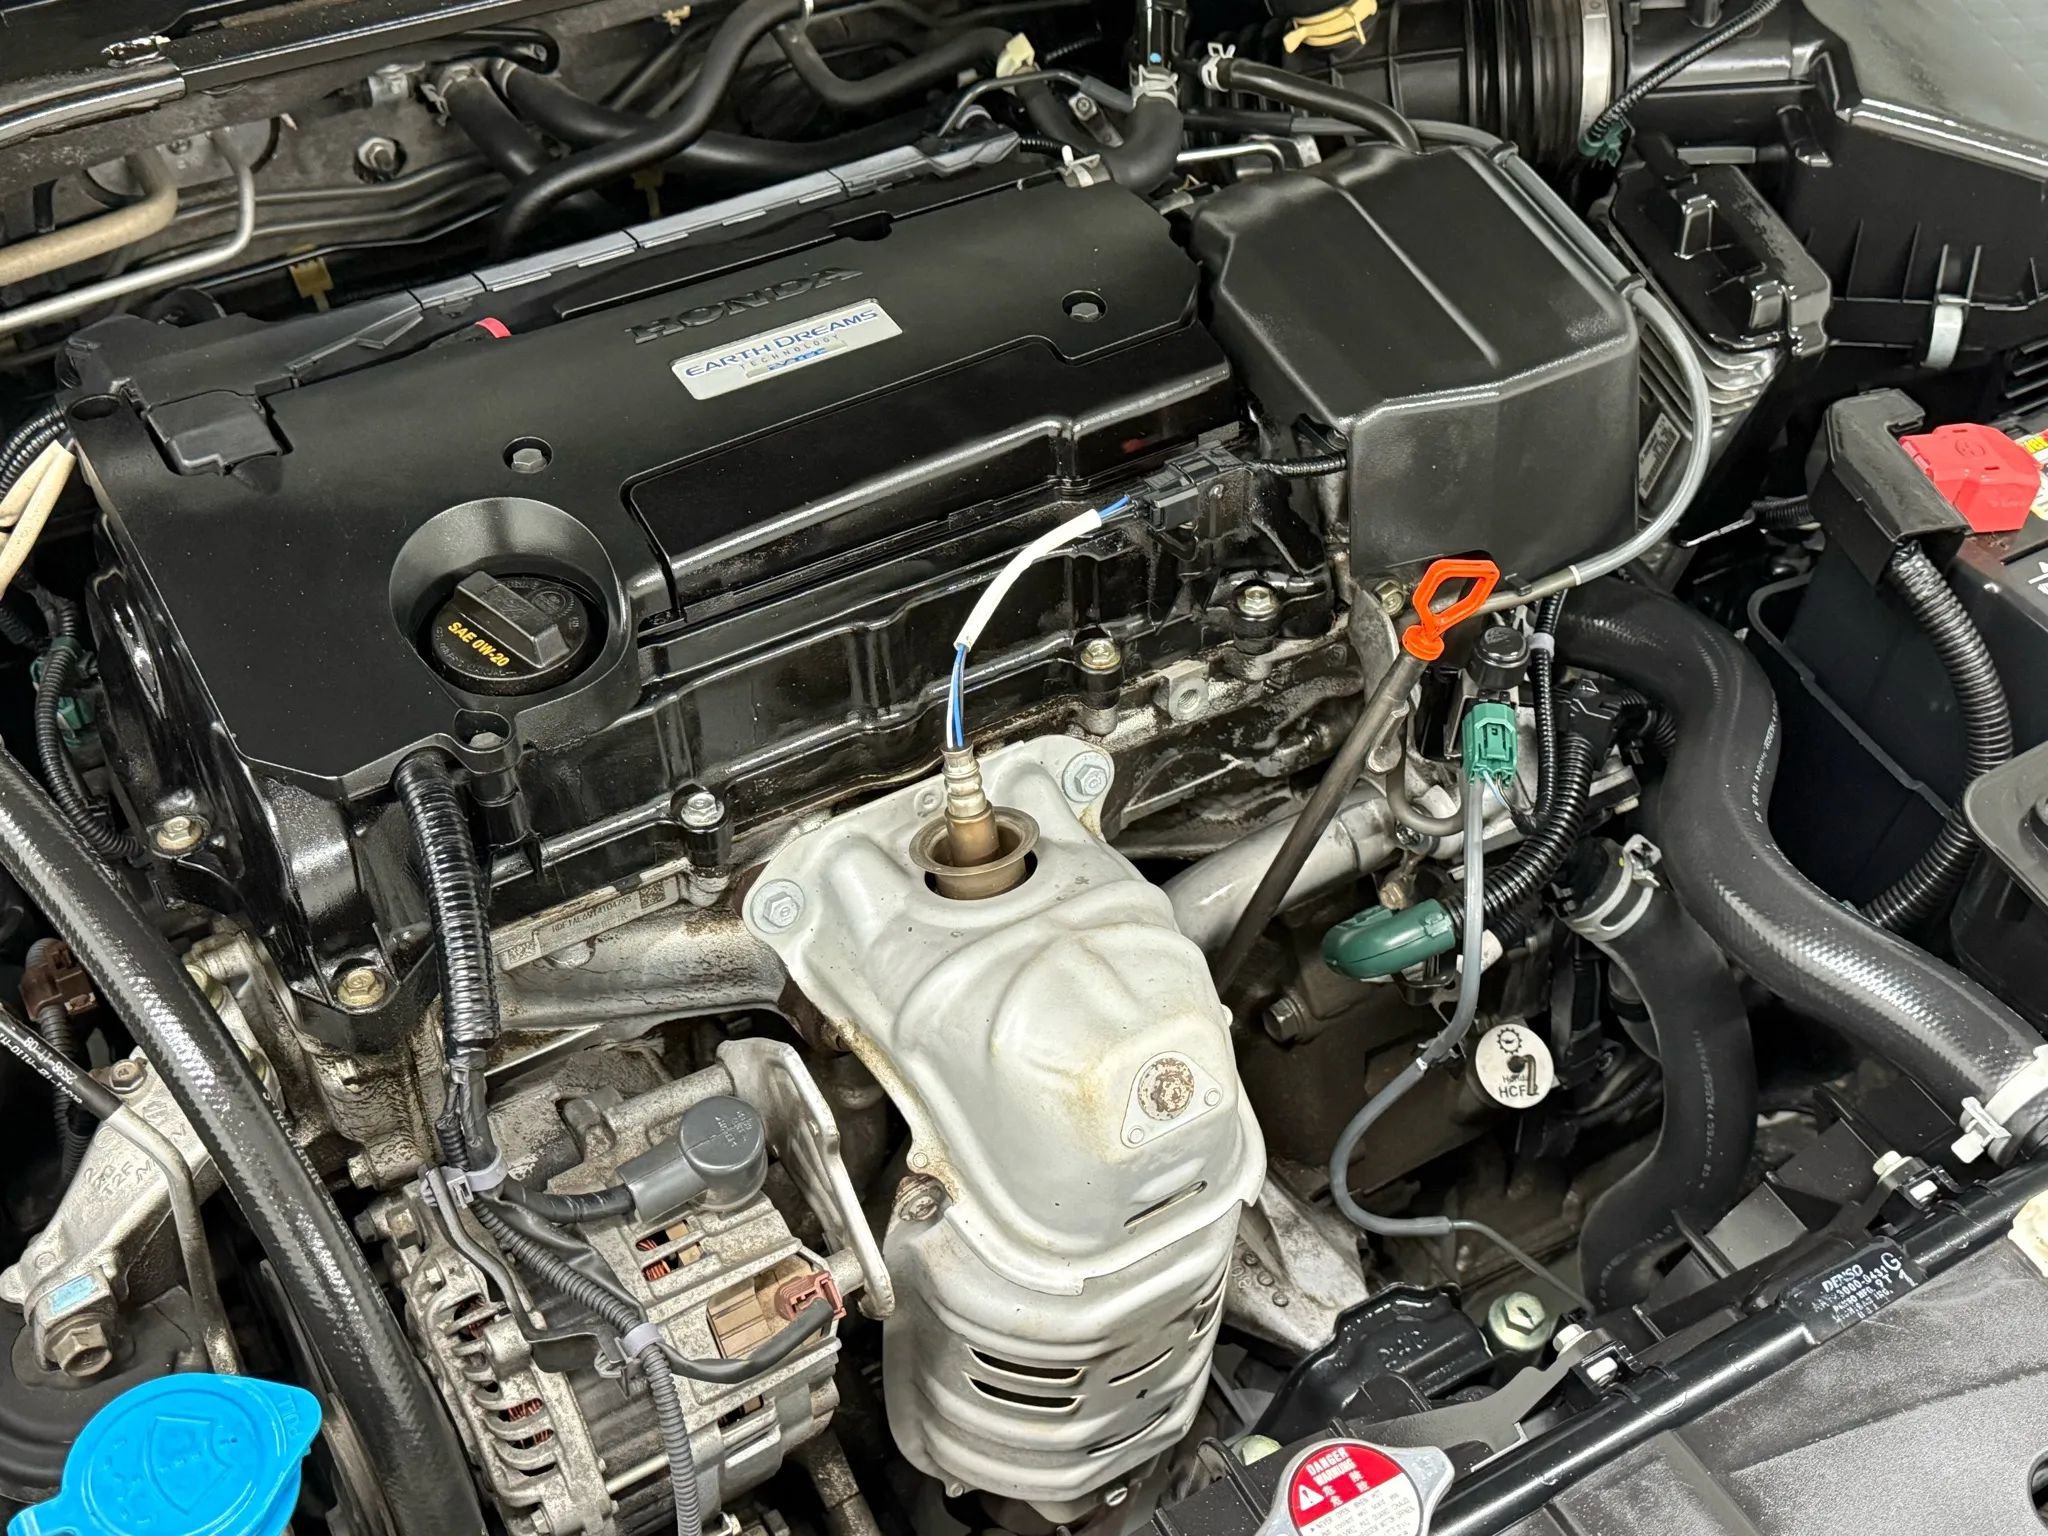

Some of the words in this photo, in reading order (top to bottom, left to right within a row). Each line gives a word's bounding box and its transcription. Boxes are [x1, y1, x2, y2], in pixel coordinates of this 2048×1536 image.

[625, 267, 863, 344] HONDA
[686, 341, 773, 376] EARTH
[774, 309, 878, 349] DREAMS
[740, 334, 839, 370] TECHNOLOGY
[447, 622, 478, 643] SAE
[471, 639, 510, 667] 0W-20
[1822, 1264, 1863, 1293] DENSO
[1306, 1446, 1349, 1475] DANGER
[1312, 1458, 1357, 1486] WARNING
